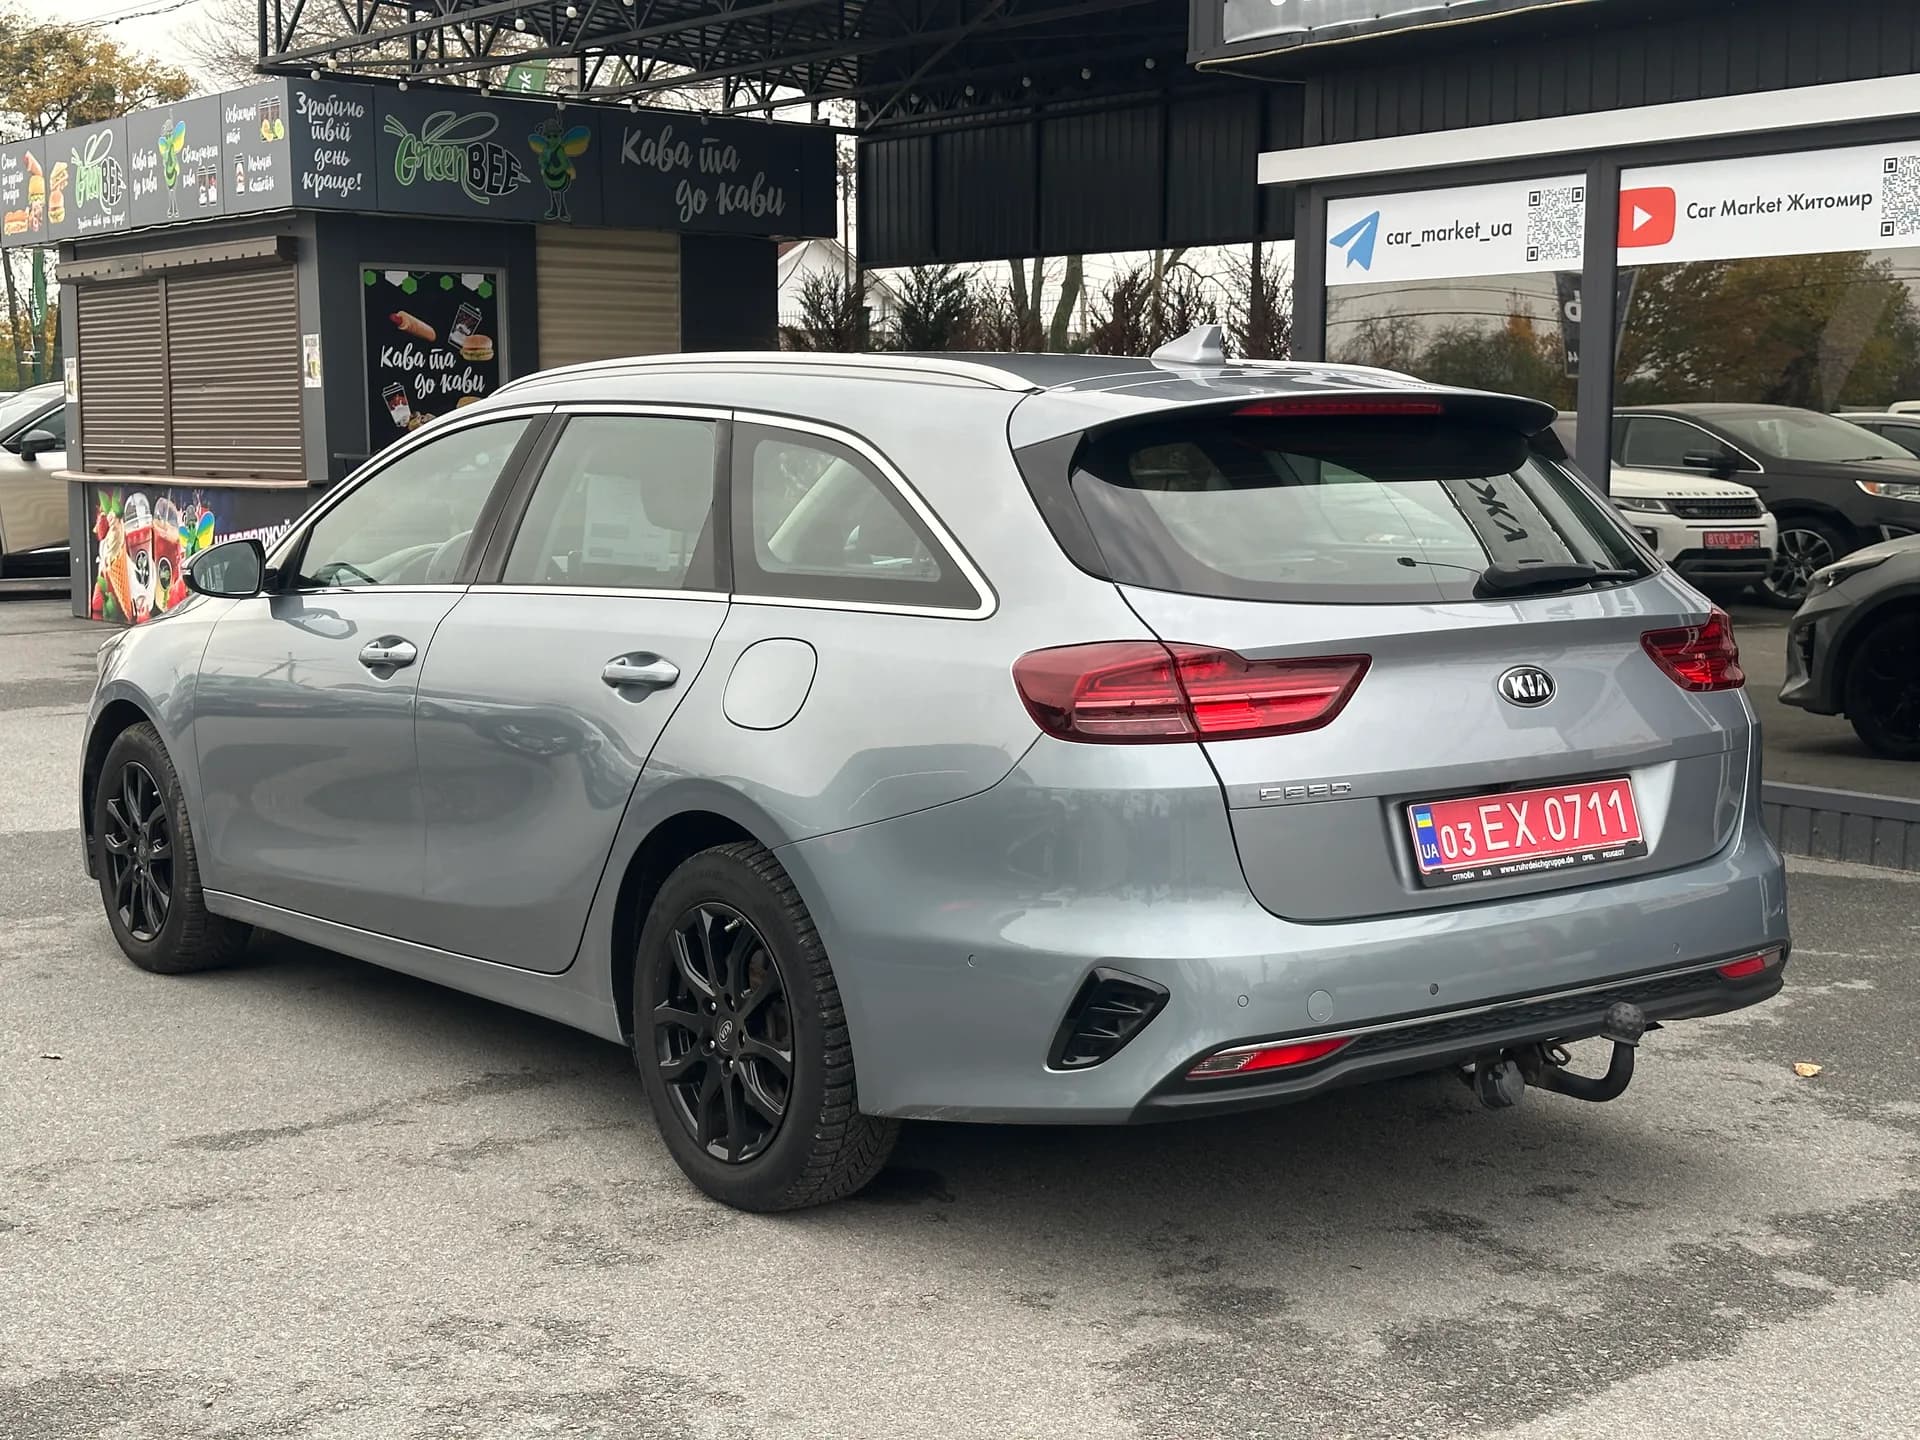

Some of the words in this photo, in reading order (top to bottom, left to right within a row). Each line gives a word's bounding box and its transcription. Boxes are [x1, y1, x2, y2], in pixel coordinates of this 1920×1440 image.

[296, 91, 365, 123] Зробимо
[311, 117, 352, 142] твій
[314, 147, 351, 171] день
[621, 125, 694, 172] Кава
[700, 138, 741, 174] та
[301, 172, 362, 198] краще!
[675, 179, 709, 223] до
[716, 171, 786, 218] кави
[1686, 202, 1716, 219] Car
[1720, 196, 1782, 217] Market
[1786, 193, 1873, 212] Житомир
[1386, 220, 1512, 247] car_market_ua
[380, 342, 425, 371] Кава
[429, 348, 456, 370] та
[414, 373, 435, 400] до
[440, 366, 485, 394] кави
[1507, 673, 1551, 699] KIA
[1259, 782, 1352, 801] CEED
[1421, 844, 1440, 860] UA
[1440, 822, 1477, 859] 03
[1478, 800, 1537, 851] EX
[1543, 789, 1628, 842] 0711
[1602, 848, 1625, 860] PEUGEOT
